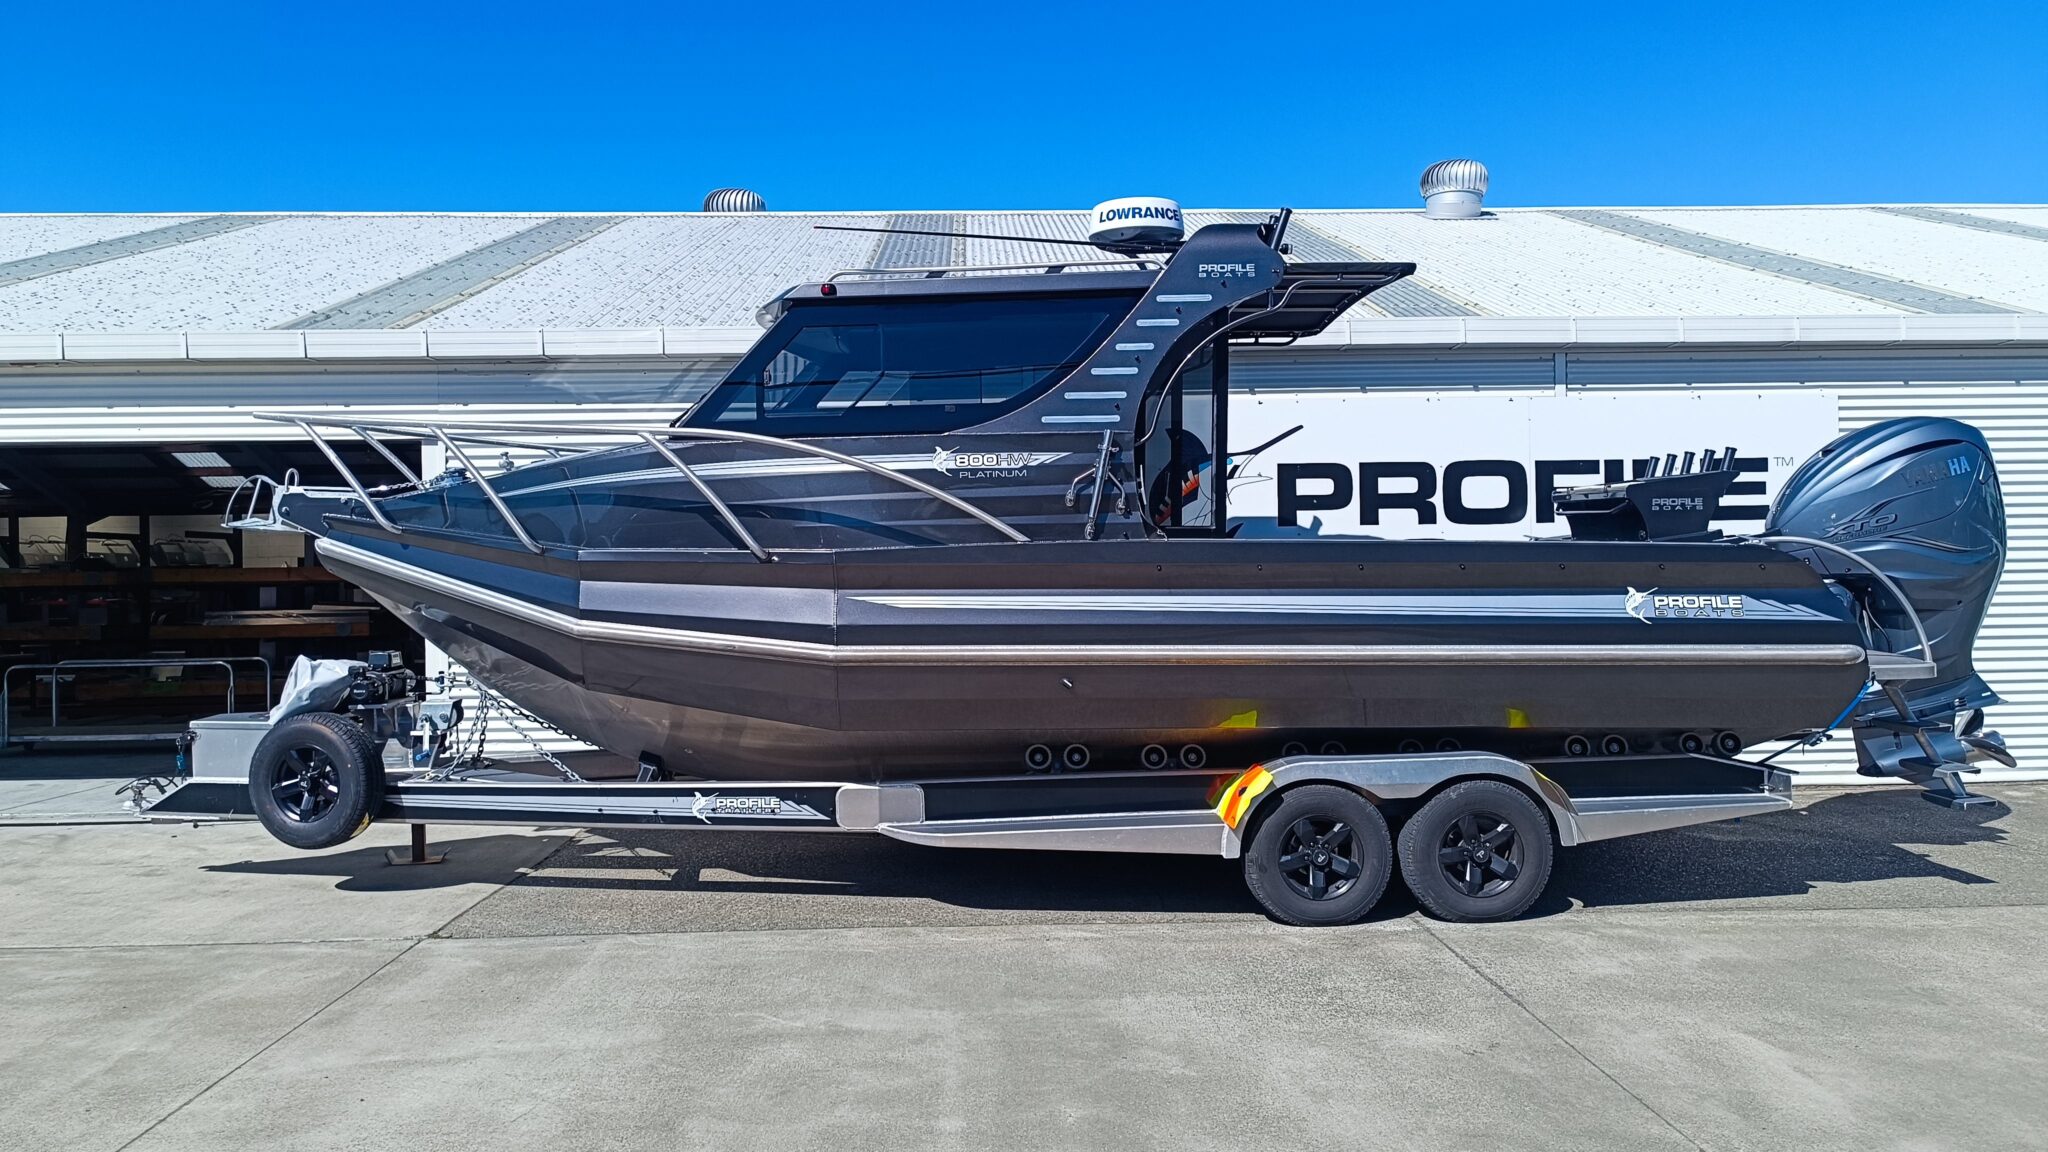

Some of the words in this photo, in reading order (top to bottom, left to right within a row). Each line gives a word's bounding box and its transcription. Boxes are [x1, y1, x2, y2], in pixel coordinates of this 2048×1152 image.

[1099, 206, 1180, 223] LOWRANCE
[1199, 263, 1255, 272] PROFILE
[955, 453, 1032, 467] 800HW
[959, 469, 1027, 479] PLATINUM
[1652, 497, 1703, 506] PROFILE
[1653, 595, 1743, 609] PROFILE
[1654, 608, 1745, 617] BOATS
[716, 798, 781, 808] PROFILE
